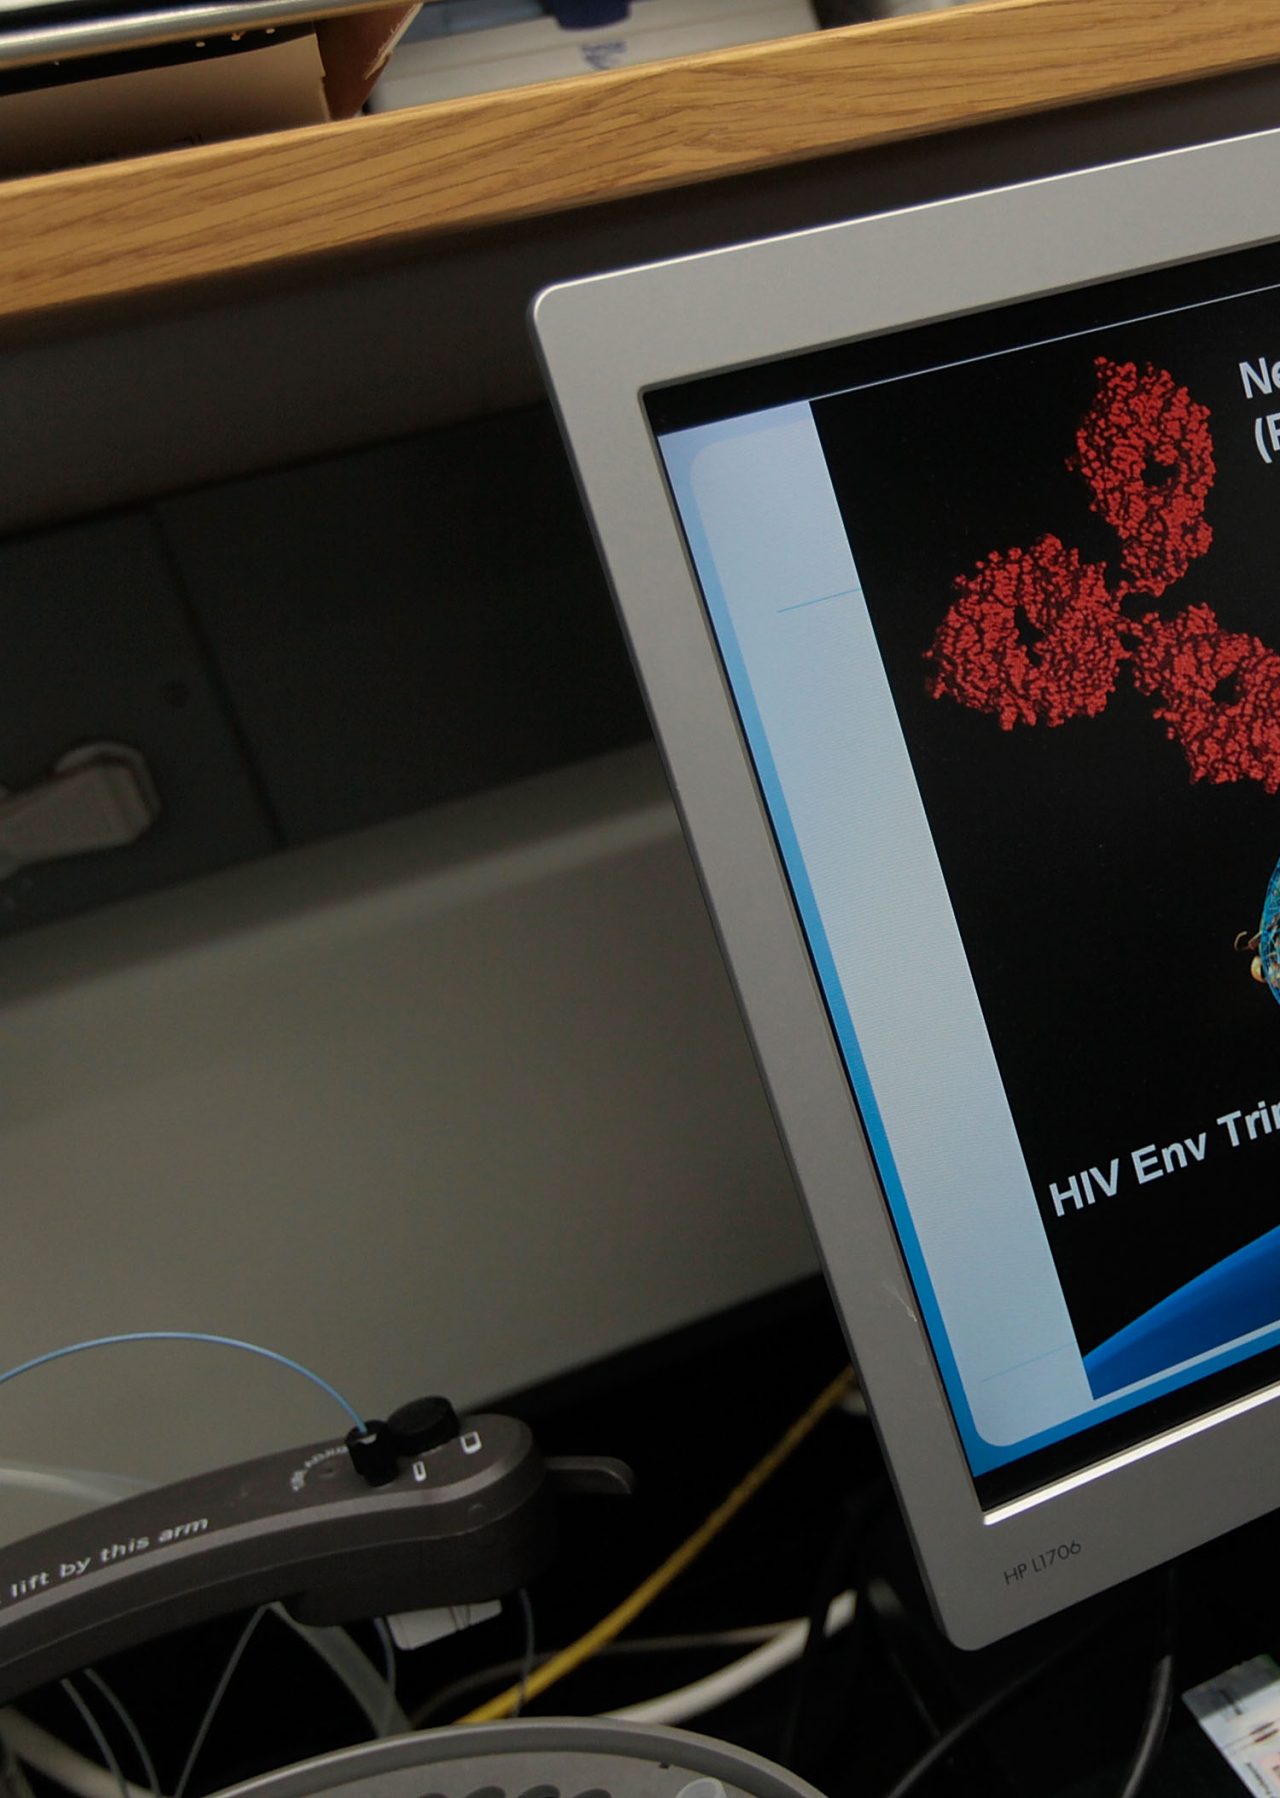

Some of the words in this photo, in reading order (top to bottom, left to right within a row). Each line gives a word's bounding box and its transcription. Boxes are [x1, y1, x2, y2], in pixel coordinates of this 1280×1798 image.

[1048, 1157, 1120, 1218] HIV
[1130, 1131, 1207, 1185] Env
[10, 1571, 50, 1598] lift
[59, 1556, 91, 1578] by
[100, 1536, 150, 1563] this
[158, 1517, 209, 1543] arm
[1003, 1563, 1028, 1585] HP
[1031, 1539, 1082, 1573] L1706
